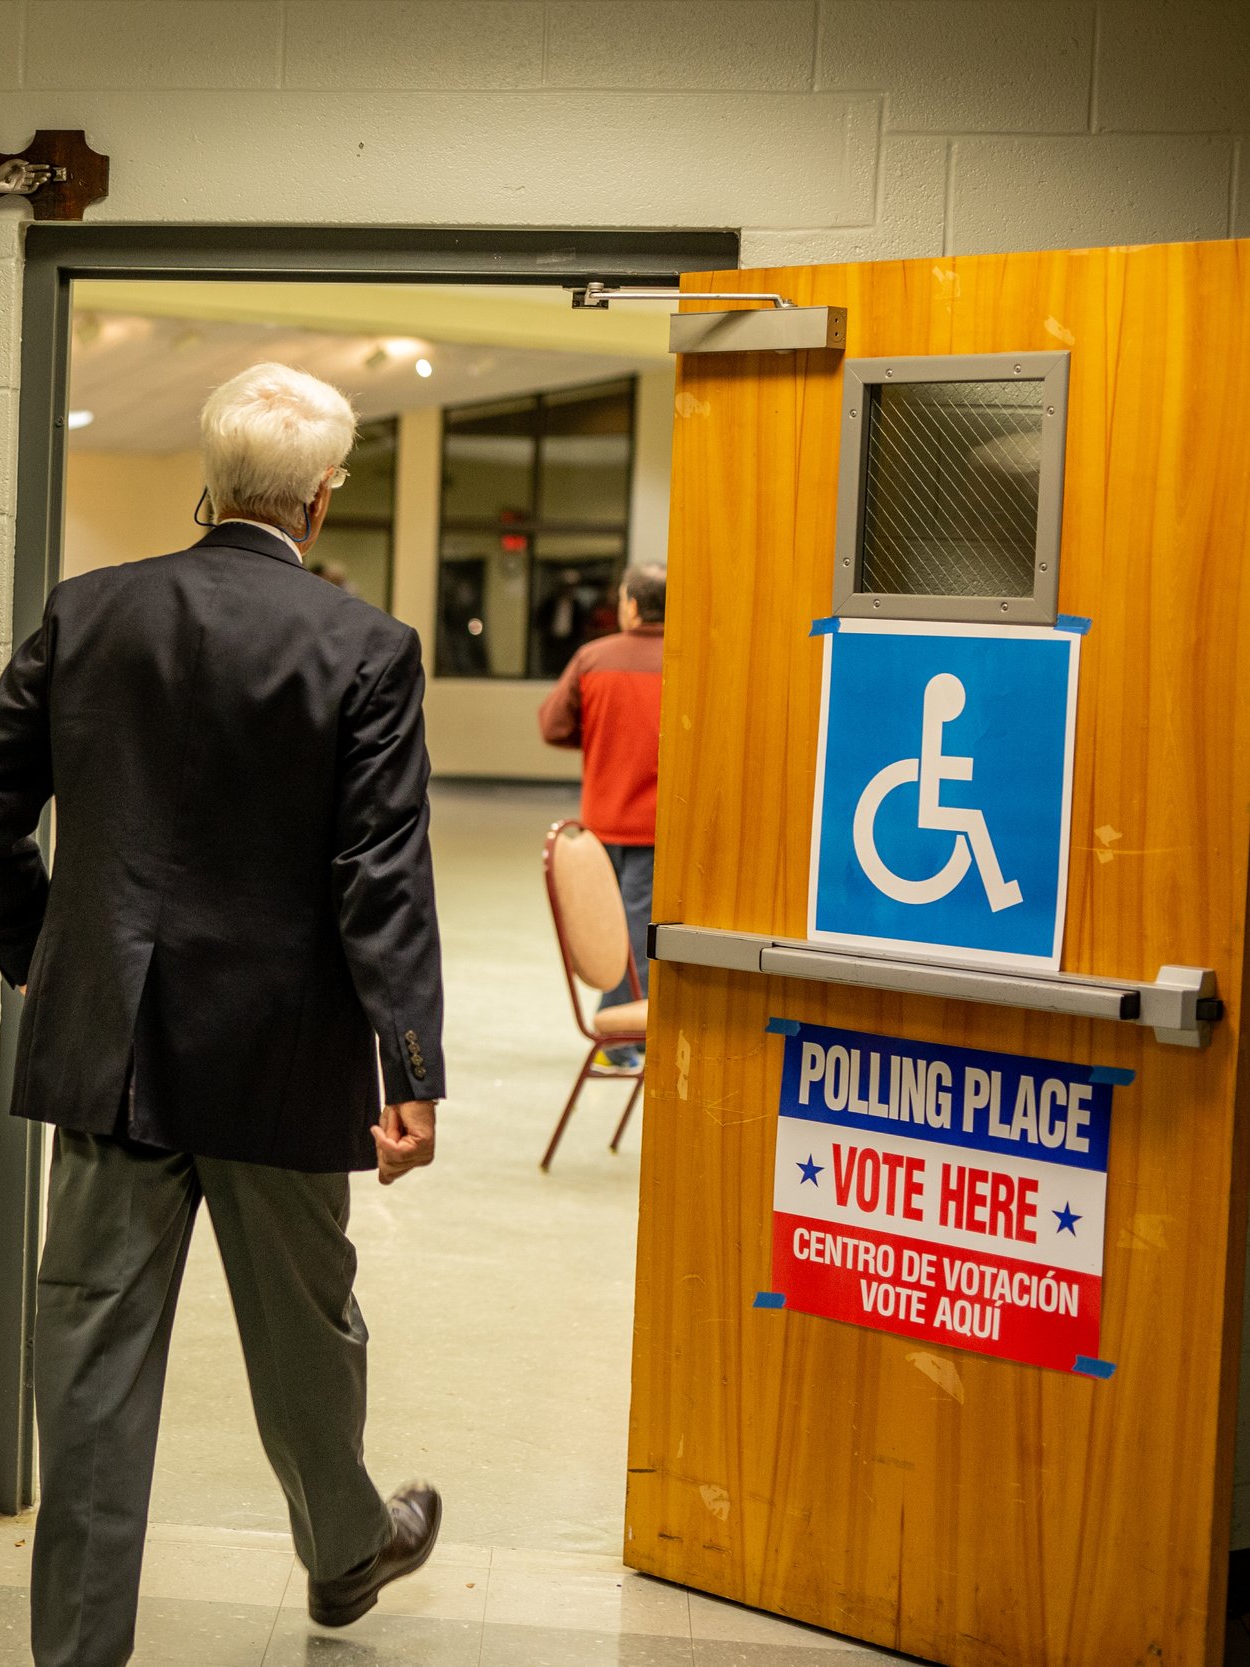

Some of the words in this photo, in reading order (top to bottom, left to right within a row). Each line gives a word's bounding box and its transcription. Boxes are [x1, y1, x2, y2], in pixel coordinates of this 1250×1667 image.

[798, 1041, 953, 1129] POLLING
[962, 1066, 1093, 1153] PLACE
[832, 1142, 926, 1222] VOTE
[938, 1162, 1039, 1245] HERE
[793, 1227, 895, 1278] CENTRO
[901, 1249, 936, 1287] DE
[942, 1257, 1079, 1318] VOTACIÓN
[860, 1279, 926, 1324] VOTE
[933, 1296, 1002, 1341] AQUÍ
